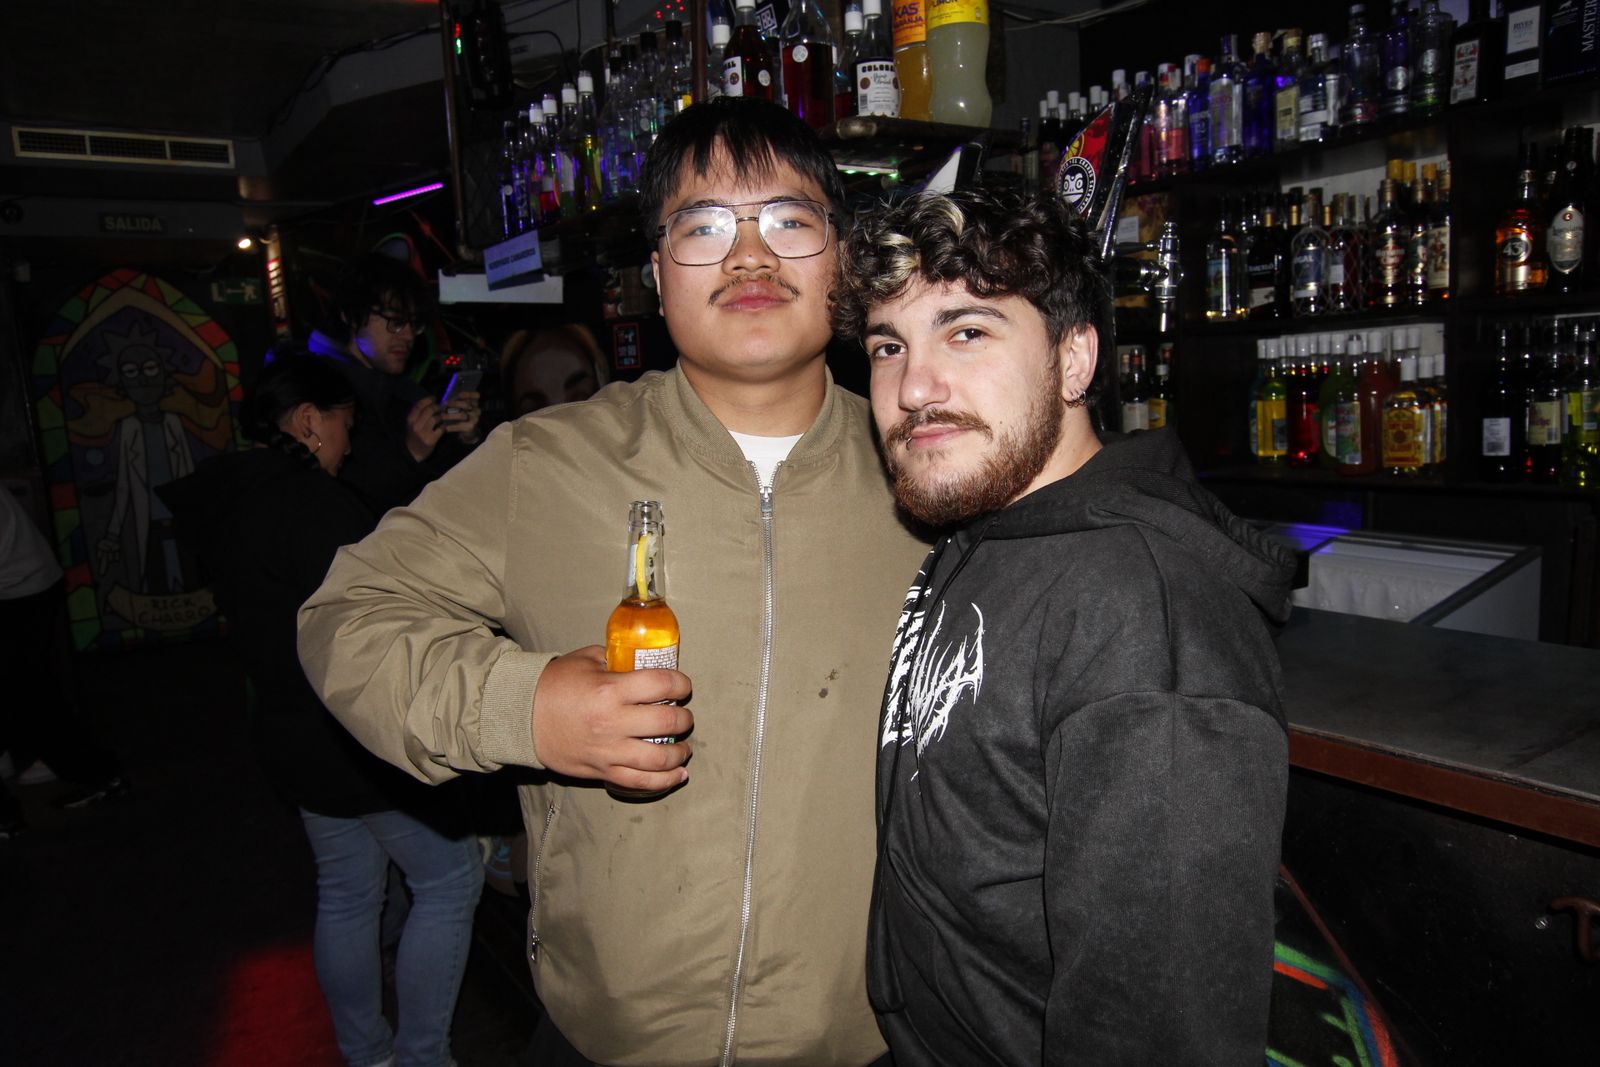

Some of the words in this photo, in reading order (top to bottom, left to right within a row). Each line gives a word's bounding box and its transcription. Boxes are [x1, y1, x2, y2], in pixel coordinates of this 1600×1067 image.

[104, 216, 163, 233] SALIDA
[1502, 241, 1521, 256] 43
[152, 598, 196, 609] RICK
[138, 606, 210, 625] CHARRO
